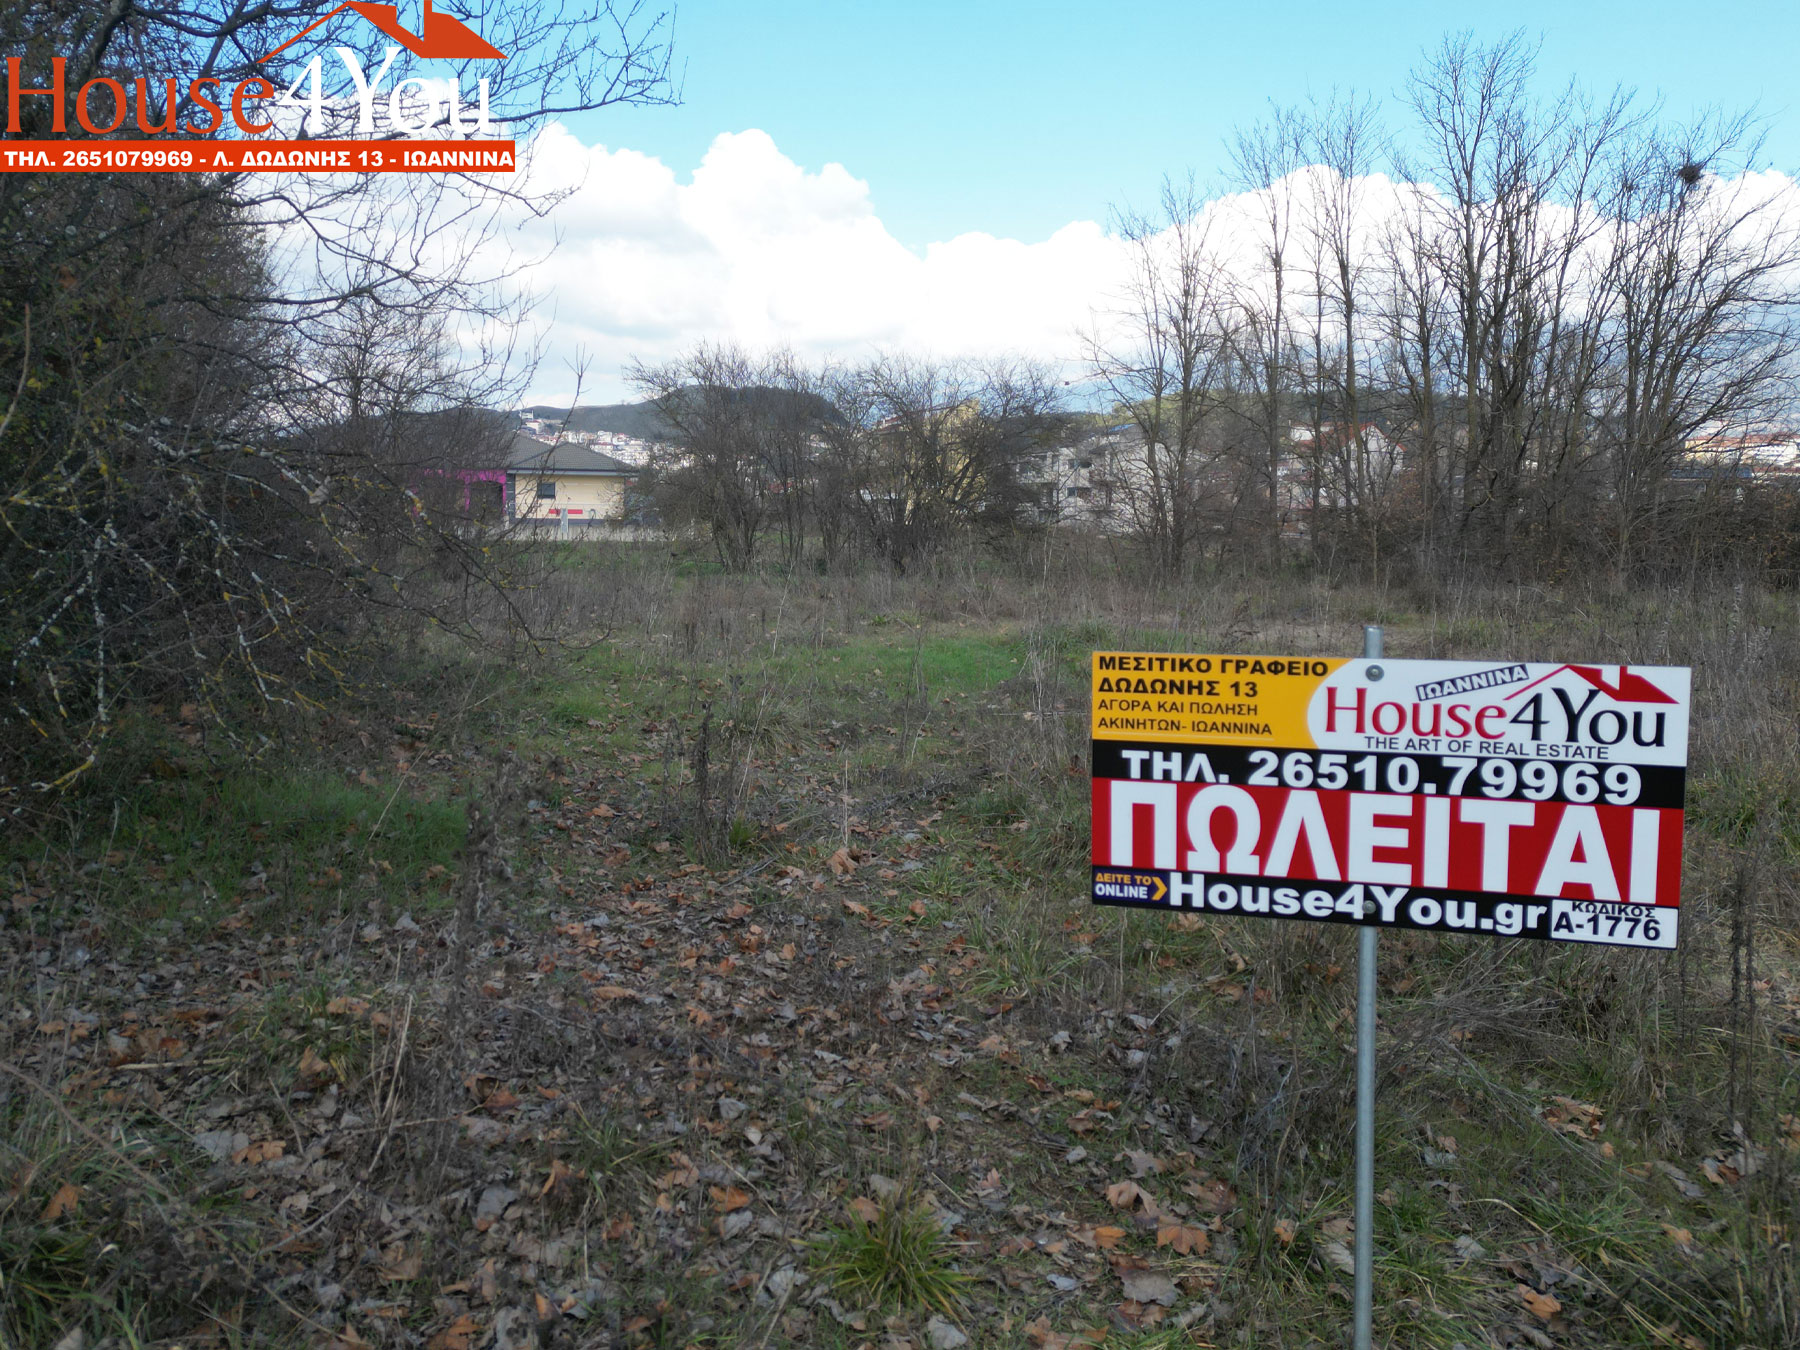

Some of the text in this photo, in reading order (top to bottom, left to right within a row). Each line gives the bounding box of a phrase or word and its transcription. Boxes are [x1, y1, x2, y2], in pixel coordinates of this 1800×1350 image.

[1099, 656, 1329, 677] ΜΕΣΙΤΙΚΟ ΓΡΑΦΕΙΟ
[1098, 677, 1258, 698] ΔΩΔΩΝΗΣ 13
[1418, 664, 1528, 701] ΙΩΑΝΝΙΝΑ
[1098, 698, 1258, 716] ΑΓΟΡΑ ΚΑΙ ΠΩΛΗΣΗ
[1325, 686, 1667, 748] House4You
[1191, 720, 1273, 736] ΙΩΑΝΝΙΝΑ
[1364, 736, 1610, 760] THE ART OF REAL ESTATE
[1121, 749, 1642, 806] ΤΗΛ. 26510.79969
[1110, 780, 1660, 904] ΠΩΛΕΙΤΑΙ
[1095, 872, 1152, 886] ΔΕΙΤΕ ΤΟ
[1095, 882, 1149, 899] ONLINE
[1169, 871, 1548, 935] House4You.gr
[1571, 901, 1656, 919] ΚΩΔΙΚΟΣ
